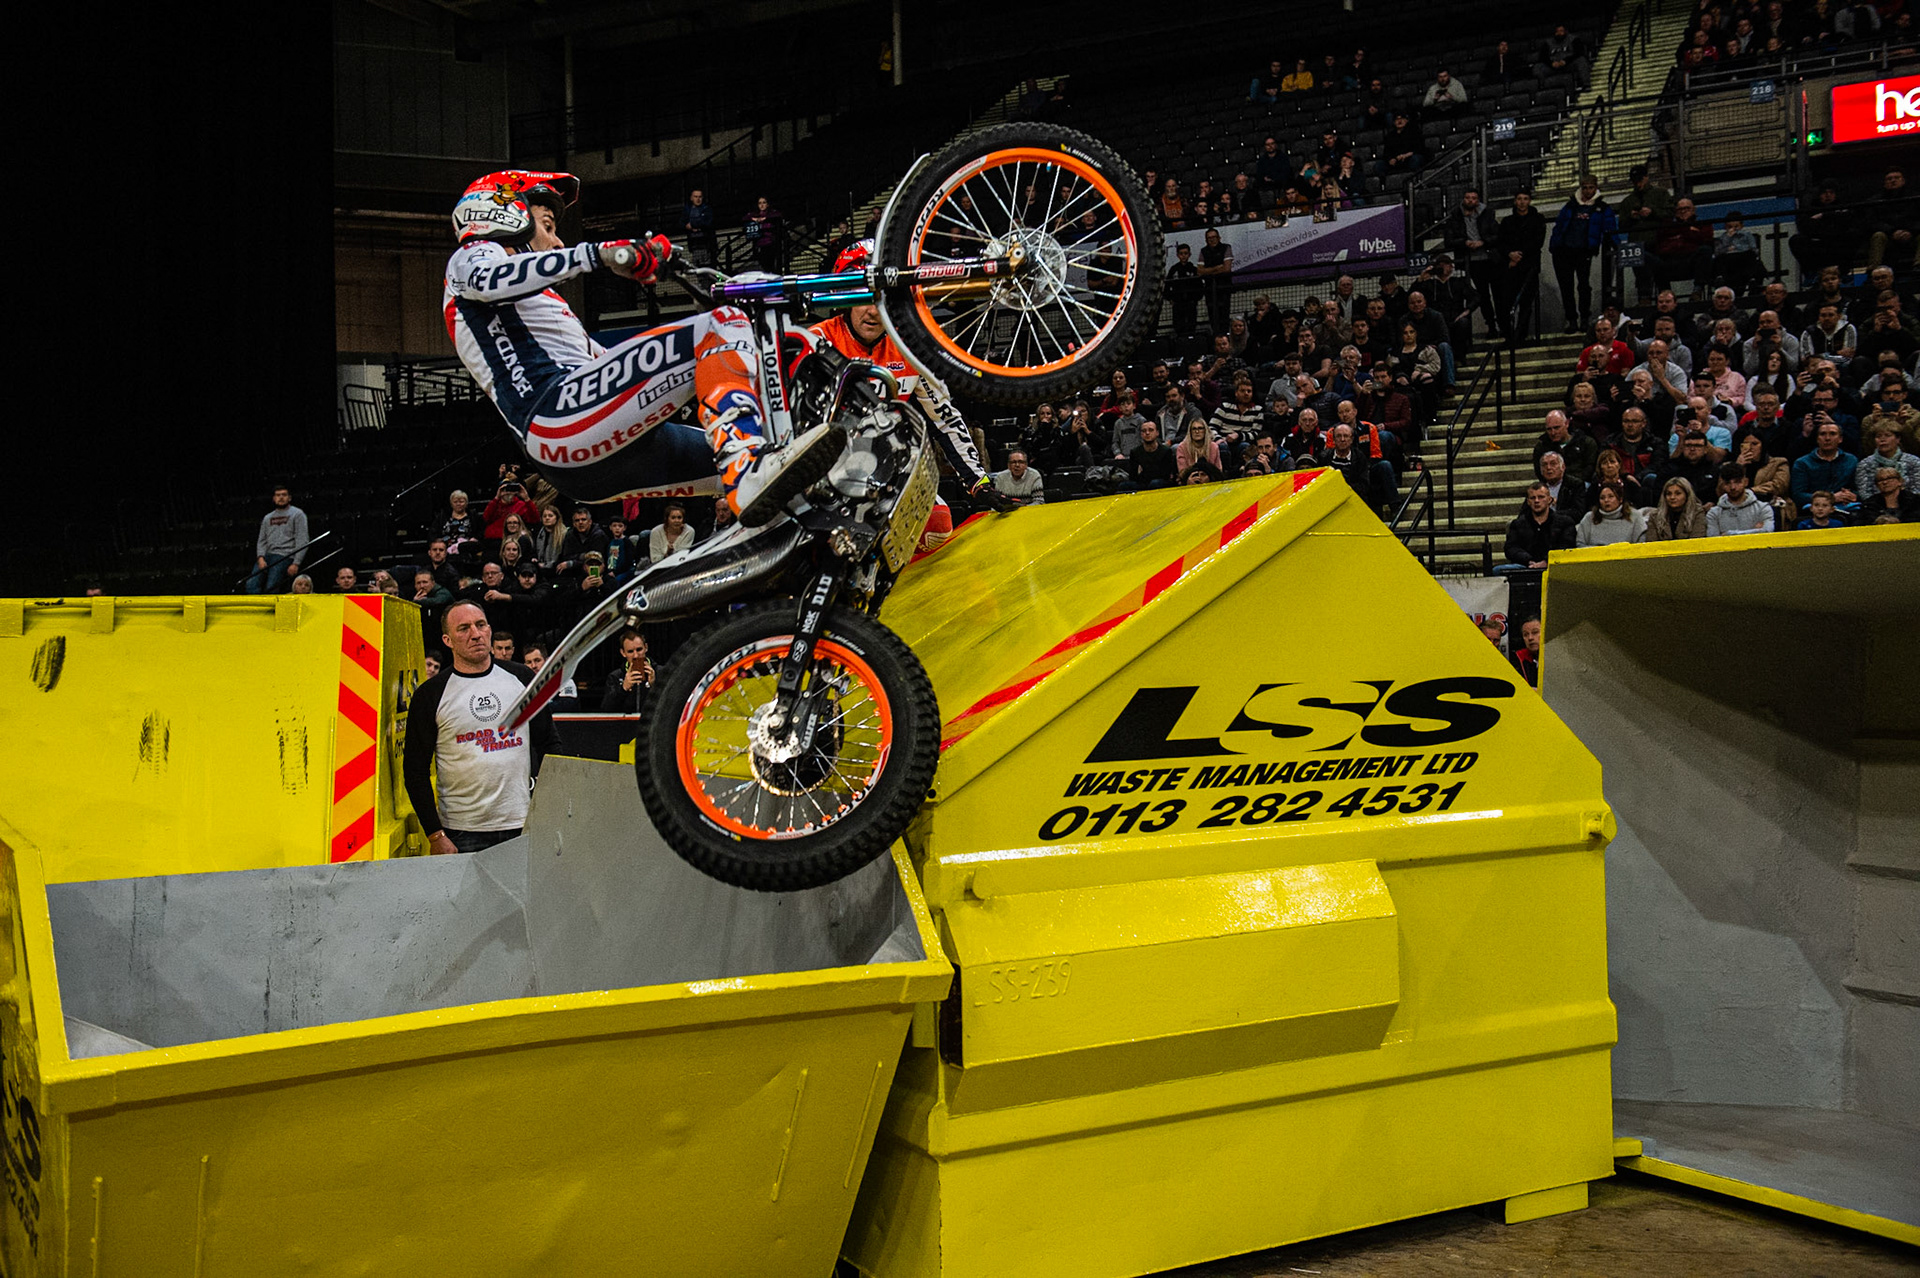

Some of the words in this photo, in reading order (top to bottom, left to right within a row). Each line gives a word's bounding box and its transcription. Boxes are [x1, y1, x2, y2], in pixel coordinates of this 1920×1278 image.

[1752, 85, 1772, 95] 218
[1494, 121, 1514, 132] 219
[1900, 121, 1916, 131] up
[1621, 247, 1642, 259] 118
[1409, 258, 1428, 267] 119
[919, 264, 966, 279] SHOWA
[486, 313, 534, 398] HONDA
[556, 333, 681, 411] REPSOL
[765, 348, 783, 412] REPSOL
[638, 366, 695, 411] hebo
[540, 402, 677, 463] Montesa
[801, 610, 818, 634] NGK
[477, 696, 492, 707] 25
[1083, 676, 1516, 764] LSS
[456, 728, 495, 744] ROAD
[475, 736, 497, 746] AND
[482, 736, 523, 753] TRIALS
[1063, 766, 1190, 798] WASTE
[1187, 754, 1424, 790] MANAGEMENT
[1421, 751, 1479, 776] LTD
[1038, 798, 1188, 841] 0113
[1196, 790, 1325, 829] 282
[1325, 780, 1467, 818] 4531
